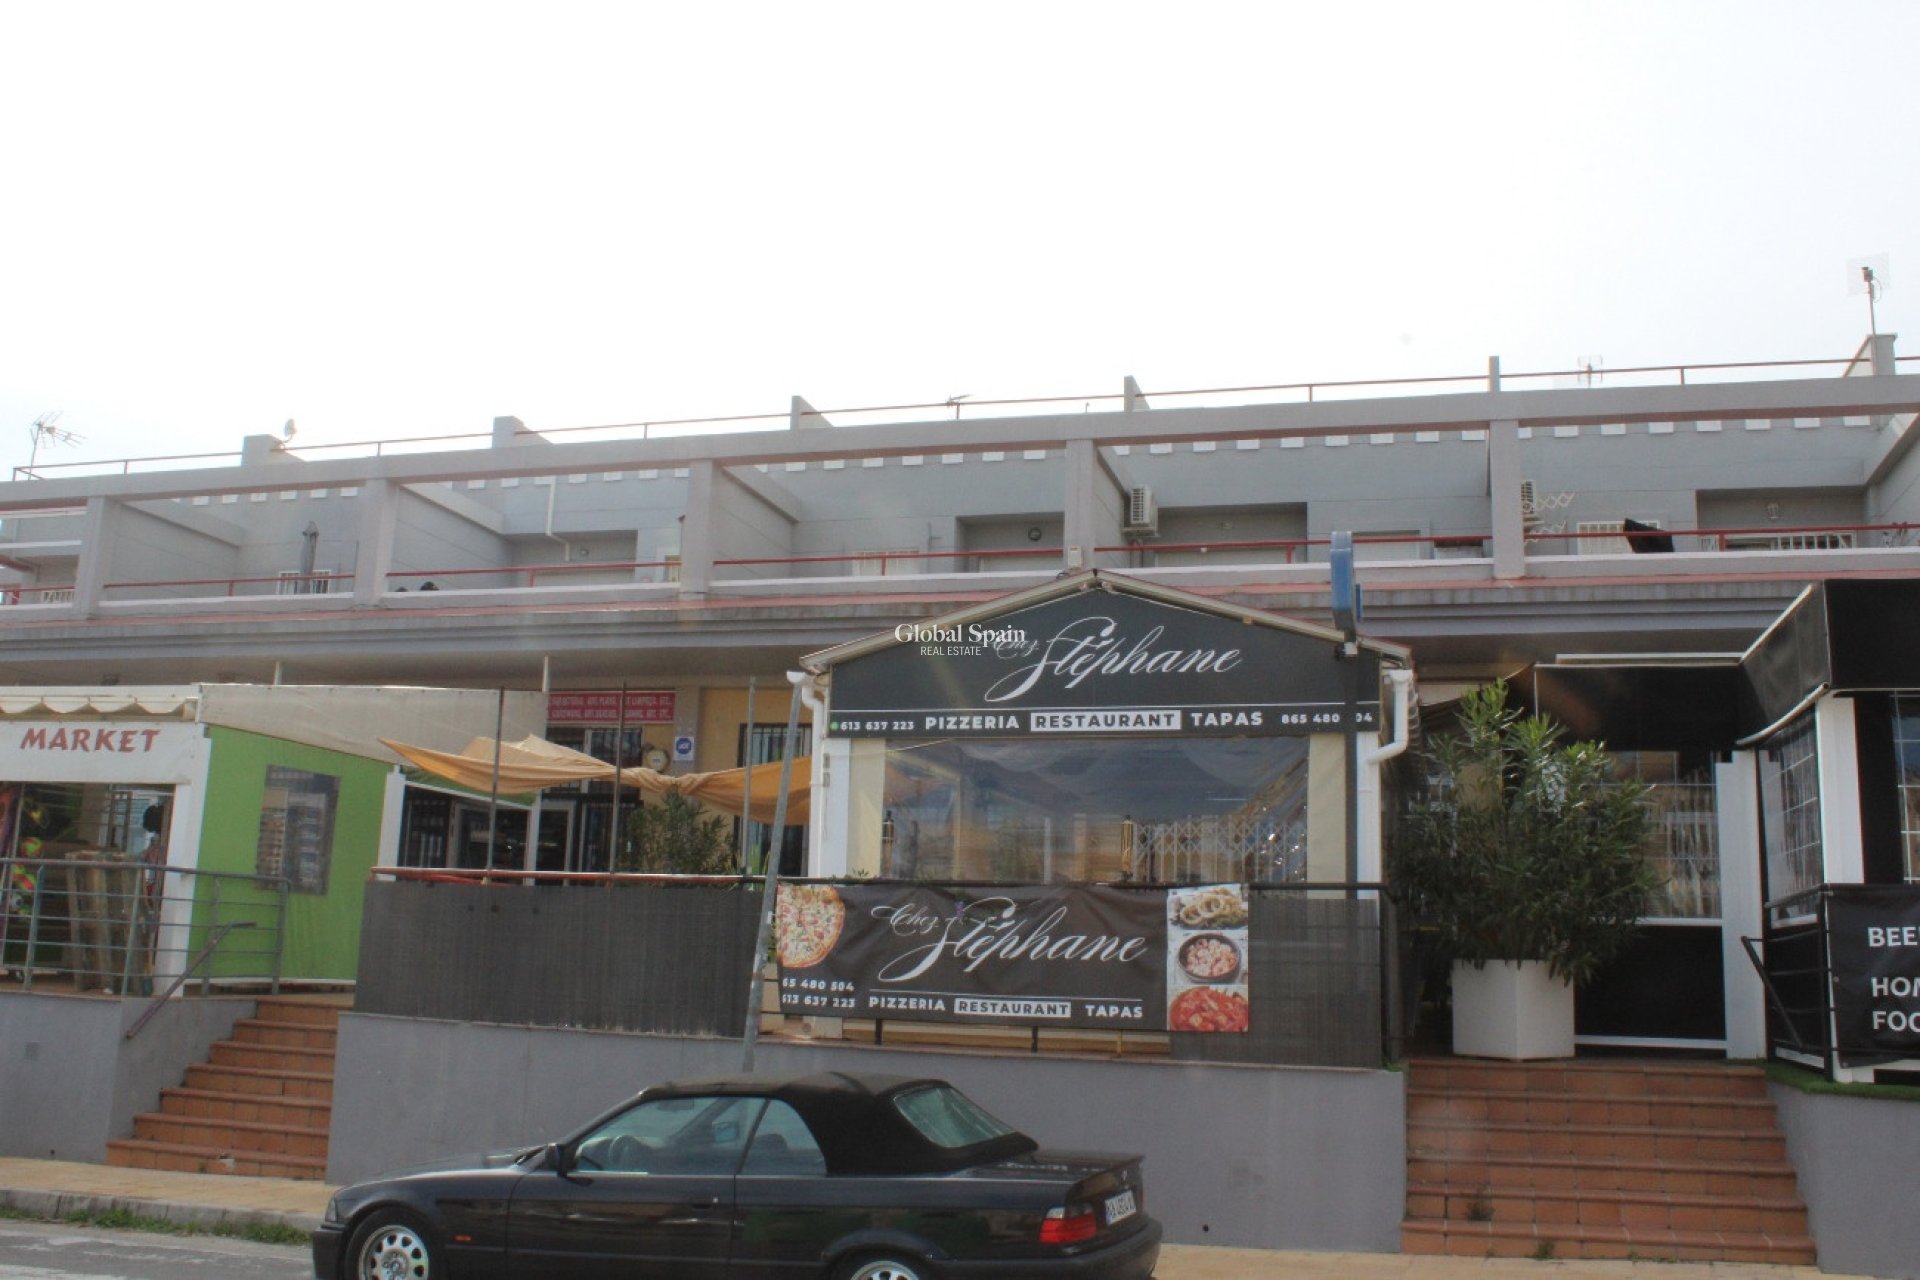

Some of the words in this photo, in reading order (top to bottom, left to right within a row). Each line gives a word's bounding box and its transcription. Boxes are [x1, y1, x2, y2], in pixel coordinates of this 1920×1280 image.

[840, 721, 861, 731] 613
[865, 721, 888, 731] 637
[893, 721, 914, 731] 223
[925, 716, 1020, 730] PIZZERIA
[1034, 712, 1175, 729] RESTAURANT
[1191, 711, 1264, 727] TAPAS
[1281, 713, 1307, 724] 865
[1312, 712, 1341, 724] 480
[20, 727, 161, 753] MARKET
[871, 903, 940, 936] Chez
[1867, 926, 1920, 947] BEE
[800, 978, 827, 990] 480
[830, 980, 855, 992] 504
[804, 994, 828, 1007] 637
[832, 996, 856, 1008] 223
[869, 996, 946, 1011] PIZZERIA
[958, 1001, 1068, 1015] RESTAURANT
[1085, 1004, 1143, 1018] TAPAS
